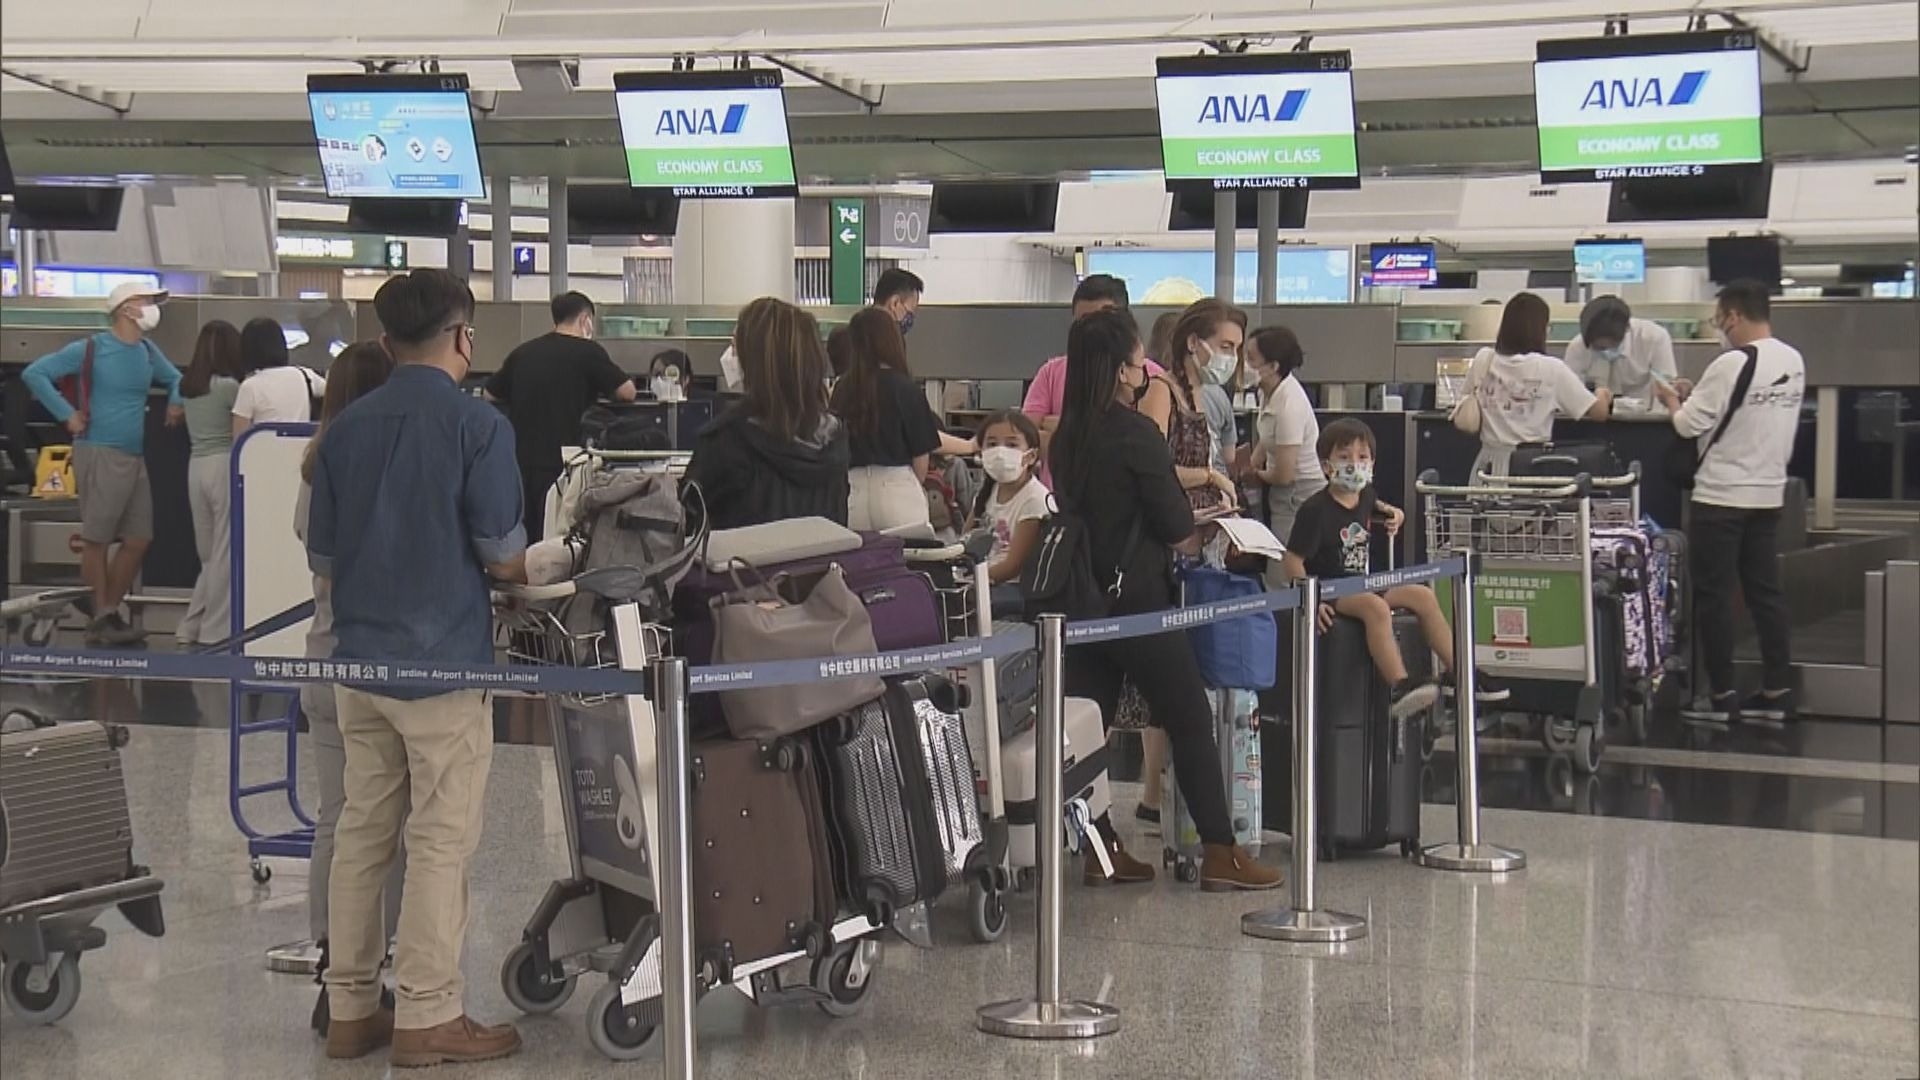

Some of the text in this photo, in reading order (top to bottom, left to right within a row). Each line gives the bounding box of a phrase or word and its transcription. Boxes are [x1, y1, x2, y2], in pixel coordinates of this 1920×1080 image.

[1320, 57, 1345, 70] E29
[753, 75, 776, 88] E30
[1580, 78, 1664, 111] ANA
[1198, 94, 1271, 123] ANA
[656, 107, 718, 136] ANA
[1577, 133, 1719, 154] ECONOMY CLASS
[1197, 148, 1321, 166] ECONOMY CLASS
[656, 159, 763, 176] ECONOMY CLASS
[1595, 166, 1690, 180] STAR ALLIANCE
[673, 185, 744, 197] STAR ALLIANCE
[1213, 177, 1296, 189] STAR ALLIANCE
[44, 654, 74, 666] Airport
[77, 656, 114, 668] Services
[116, 657, 149, 669] Limited
[254, 660, 389, 681] 怡中航空服務有限公司
[431, 669, 462, 682] Airport
[465, 671, 503, 682] Services
[505, 672, 540, 684] Limited
[704, 672, 730, 684] Services
[730, 669, 753, 681] Limited
[576, 769, 595, 785] TOTO
[578, 788, 613, 806] WASHLET
